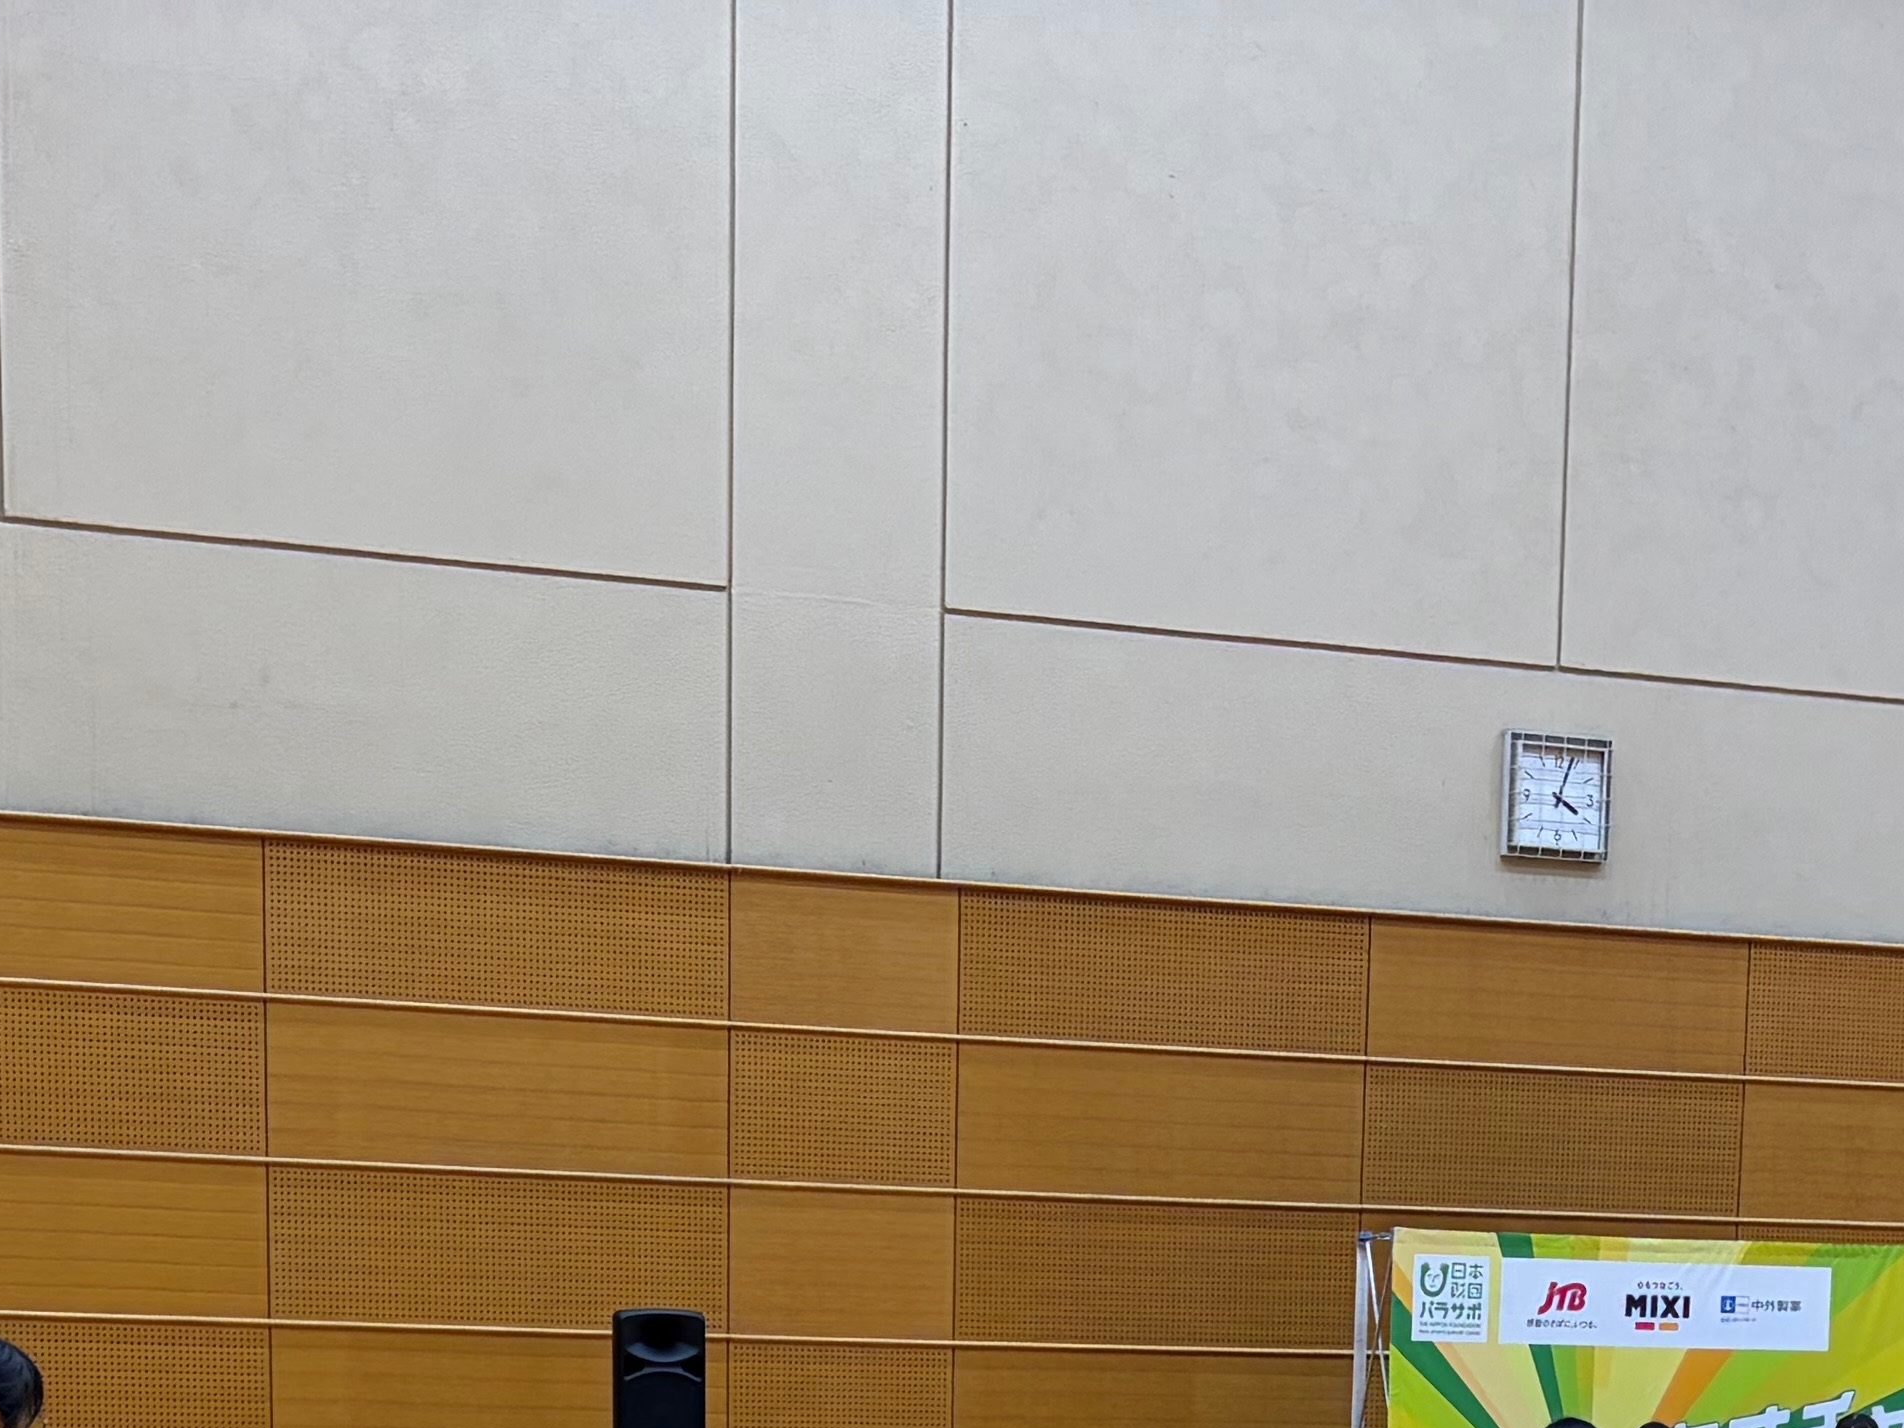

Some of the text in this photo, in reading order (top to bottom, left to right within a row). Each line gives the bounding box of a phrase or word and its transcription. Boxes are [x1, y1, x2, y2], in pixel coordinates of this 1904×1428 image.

[1523, 788, 1531, 802] 9
[1586, 794, 1594, 808] 3
[1553, 829, 1562, 842] 6
[1451, 1262, 1484, 1280] 日本
[1537, 1281, 1587, 1315] JTB
[1625, 1294, 1690, 1319] MIXI
[1419, 1302, 1482, 1320] パラサポ
